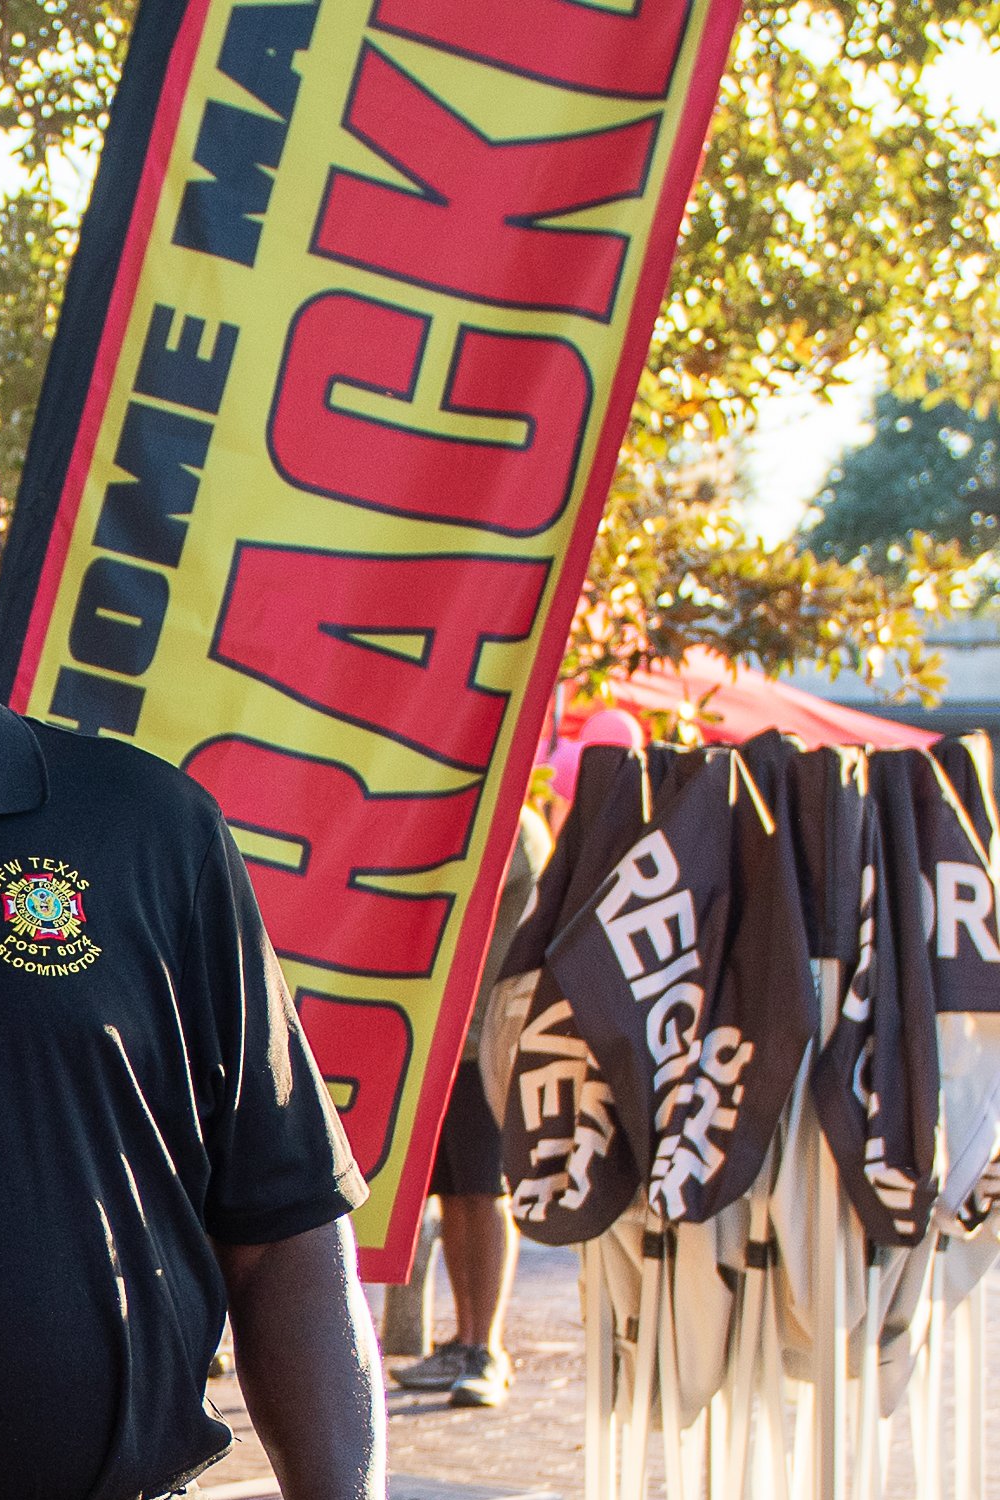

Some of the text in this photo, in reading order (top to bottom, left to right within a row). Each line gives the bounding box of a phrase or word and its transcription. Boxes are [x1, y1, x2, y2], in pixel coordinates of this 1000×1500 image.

[46, 303, 240, 738] HOME
[28, 856, 90, 891] TEXAS
[4, 934, 92, 957] POST 6074
